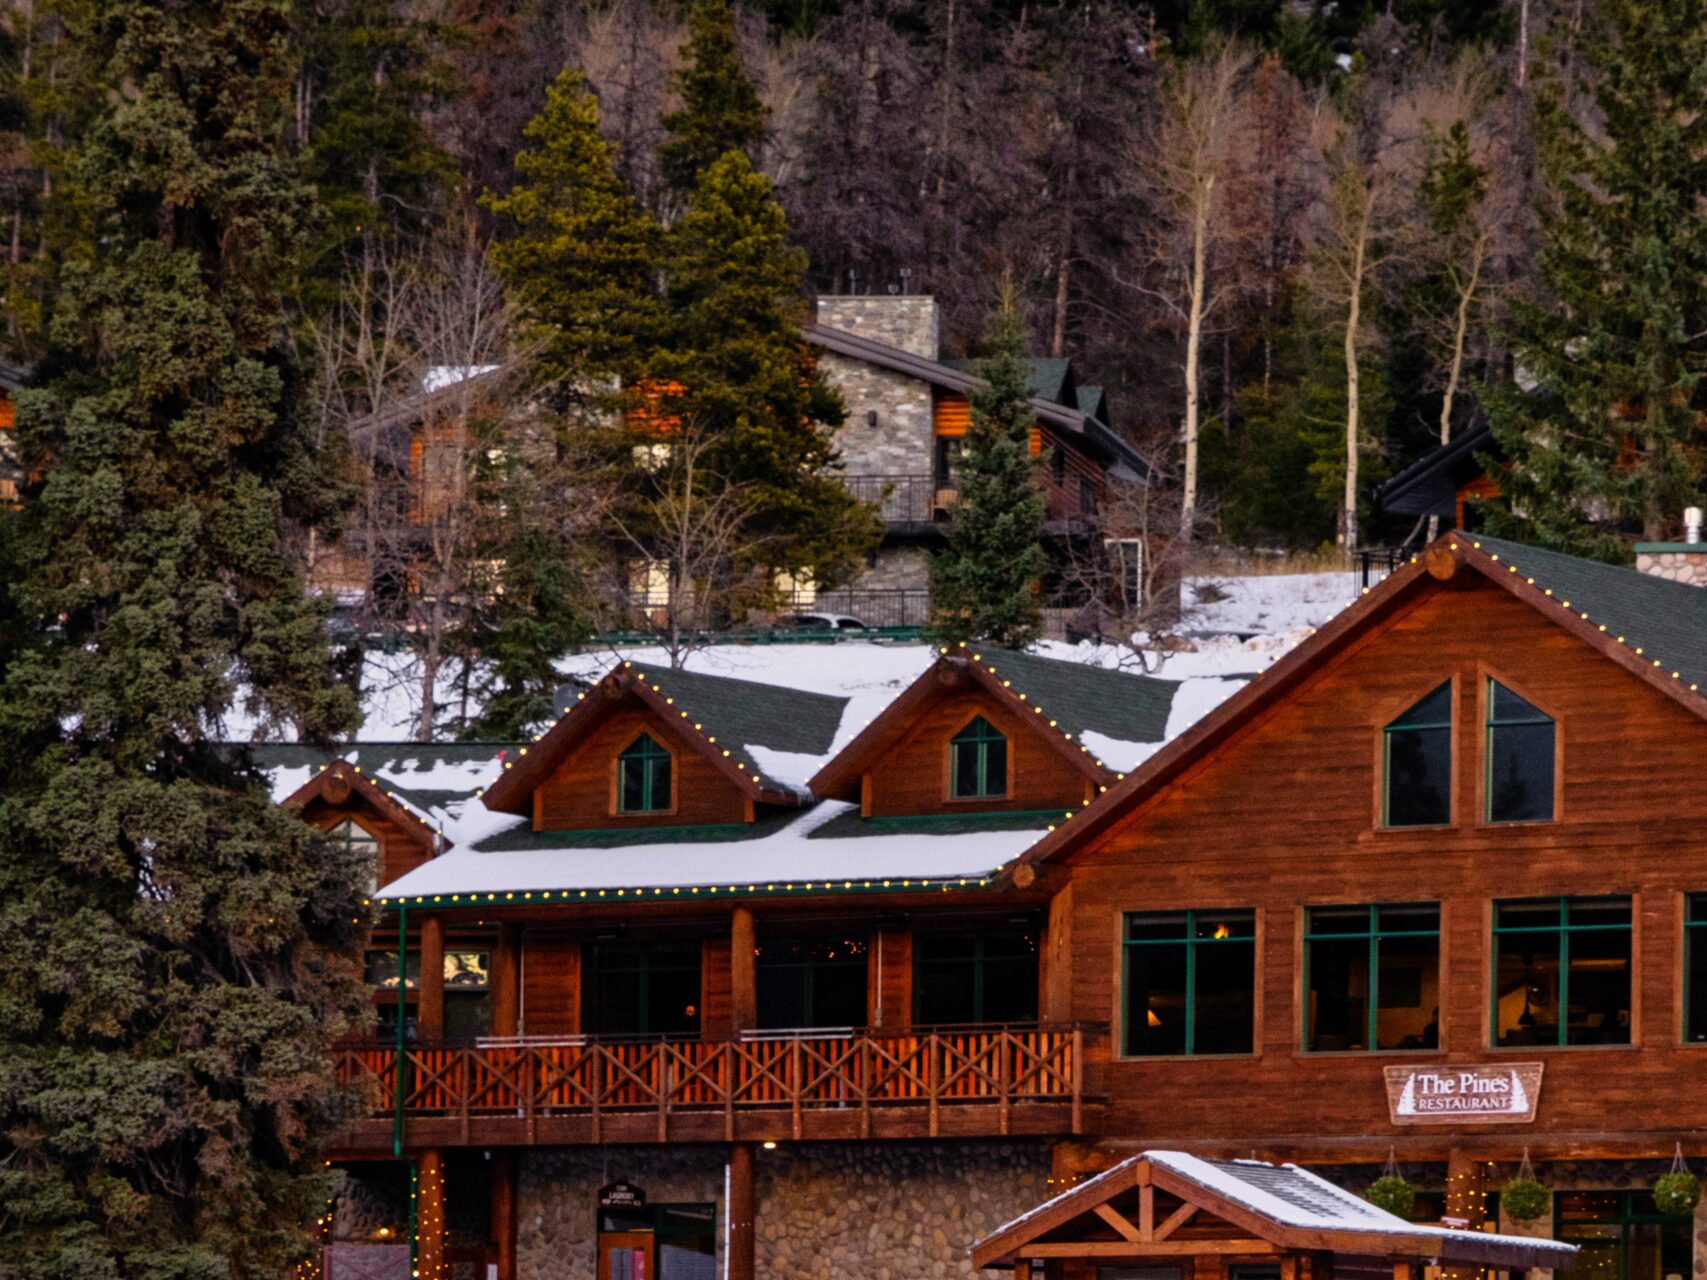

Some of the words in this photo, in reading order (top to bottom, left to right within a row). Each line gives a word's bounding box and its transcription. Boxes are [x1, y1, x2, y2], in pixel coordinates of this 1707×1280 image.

[1417, 1074, 1455, 1094] The
[1459, 1073, 1509, 1093] Pines
[1418, 1097, 1508, 1110] RESTAURANT
